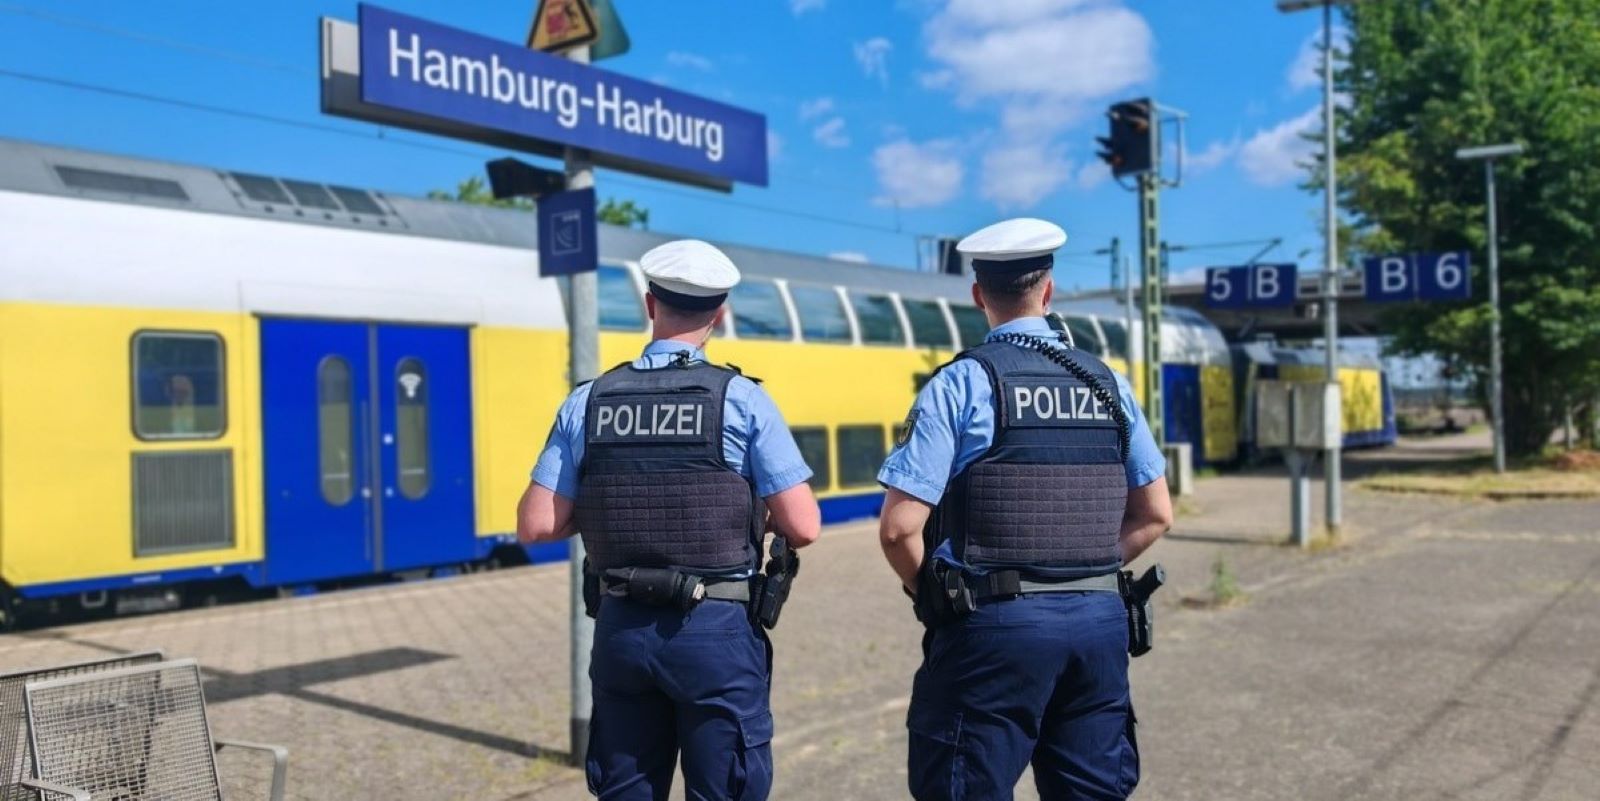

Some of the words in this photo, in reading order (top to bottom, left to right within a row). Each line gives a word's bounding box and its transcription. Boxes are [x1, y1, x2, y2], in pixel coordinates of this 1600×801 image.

[388, 29, 724, 162] Hamburg-Harburg
[1210, 269, 1232, 301] 5
[1256, 267, 1279, 299] B
[1381, 258, 1407, 292] B
[1435, 252, 1462, 290] 6
[597, 404, 703, 436] POLIZEI
[1014, 386, 1114, 420] POLIZE
